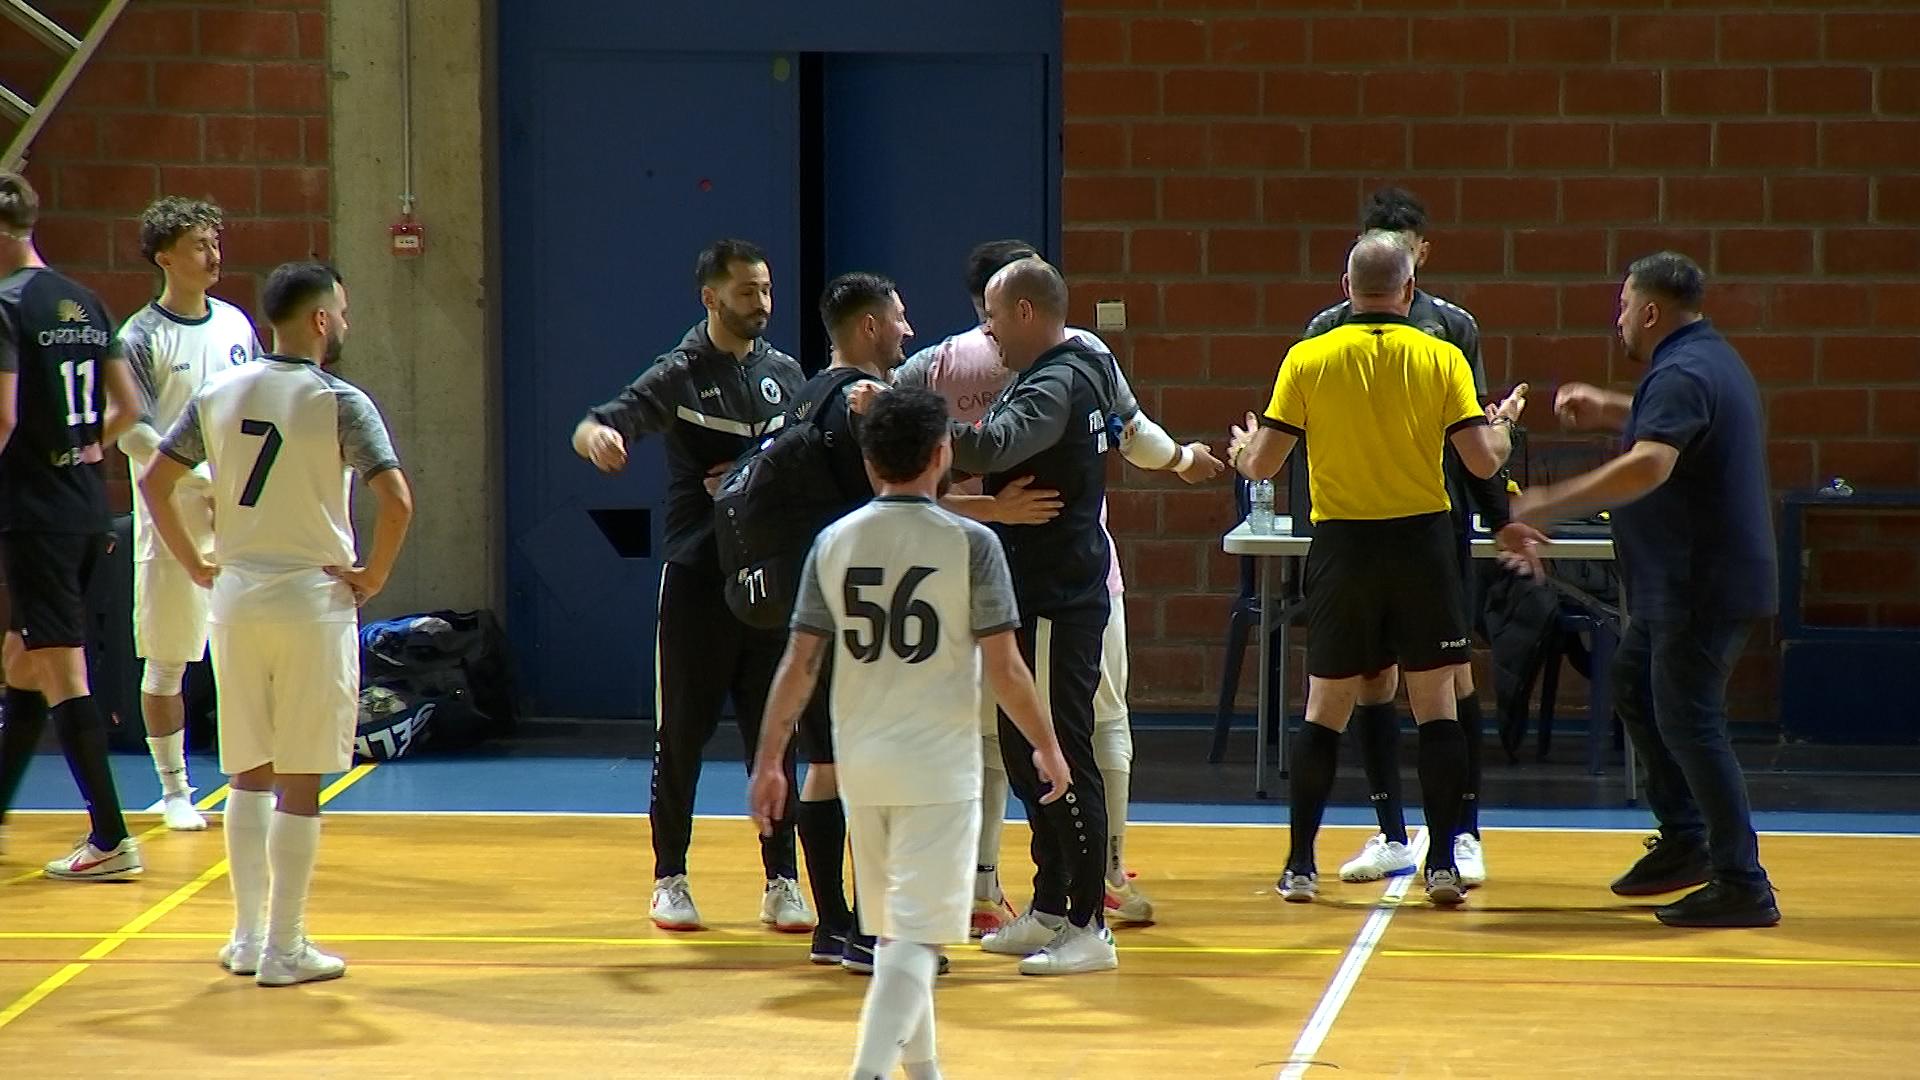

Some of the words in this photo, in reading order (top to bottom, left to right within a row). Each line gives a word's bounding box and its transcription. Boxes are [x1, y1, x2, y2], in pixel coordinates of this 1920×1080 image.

[59, 359, 98, 426] 11
[238, 418, 284, 507] 7
[842, 565, 941, 664] 56
